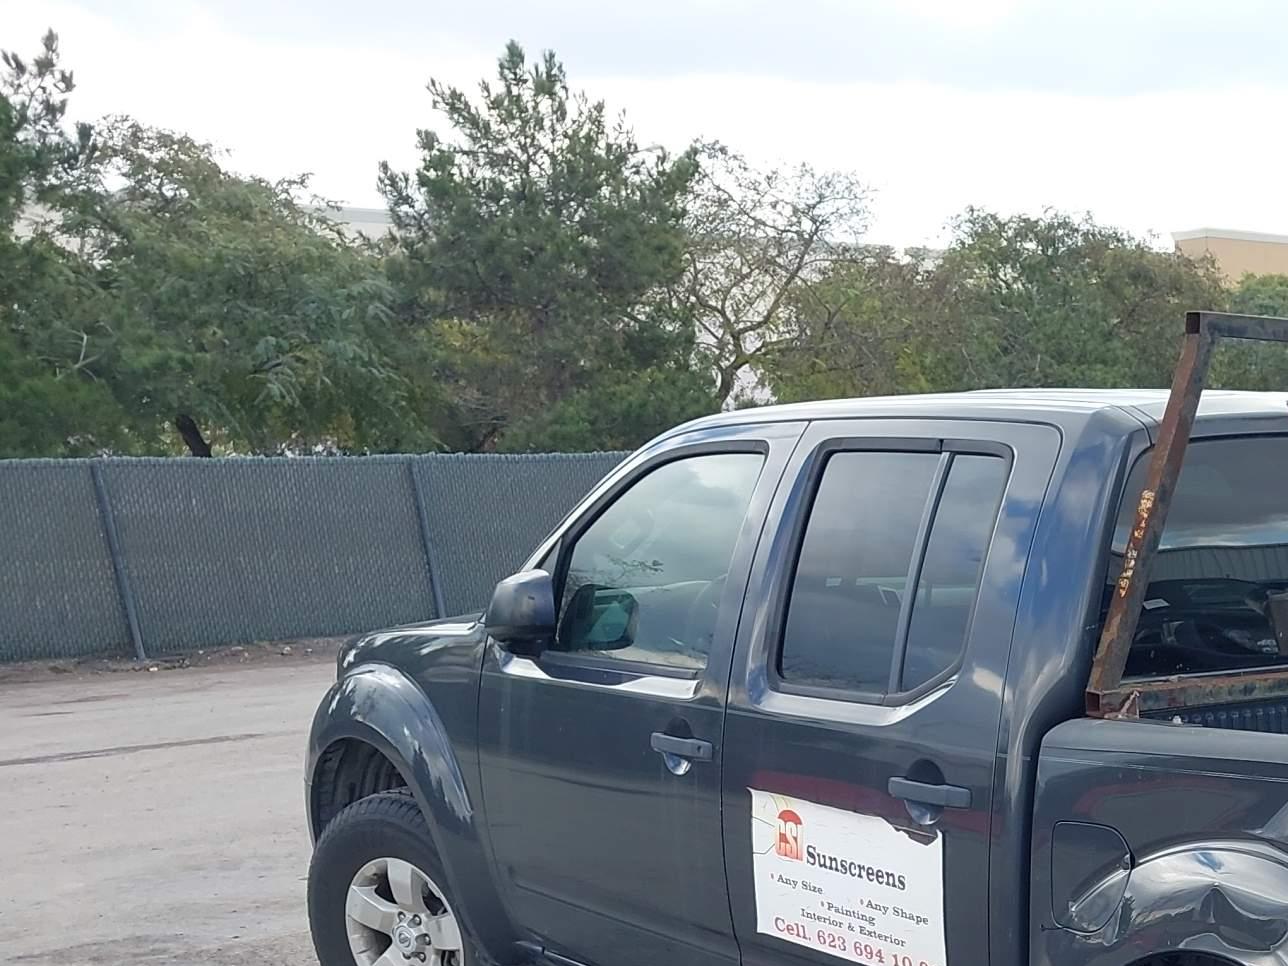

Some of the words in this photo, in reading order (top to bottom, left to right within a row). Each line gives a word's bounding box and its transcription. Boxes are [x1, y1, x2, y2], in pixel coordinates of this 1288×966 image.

[777, 874, 798, 889] Any
[801, 880, 823, 895] Size
[806, 845, 906, 891] Sunscreens
[800, 908, 844, 929] Interior
[847, 922, 856, 932] &
[859, 926, 907, 948] Exterior
[826, 902, 876, 926] Painting
[866, 900, 889, 916] Any
[892, 906, 929, 926] Shape
[774, 916, 812, 941] Cell.
[817, 930, 847, 951] 623
[853, 941, 885, 964] 694
